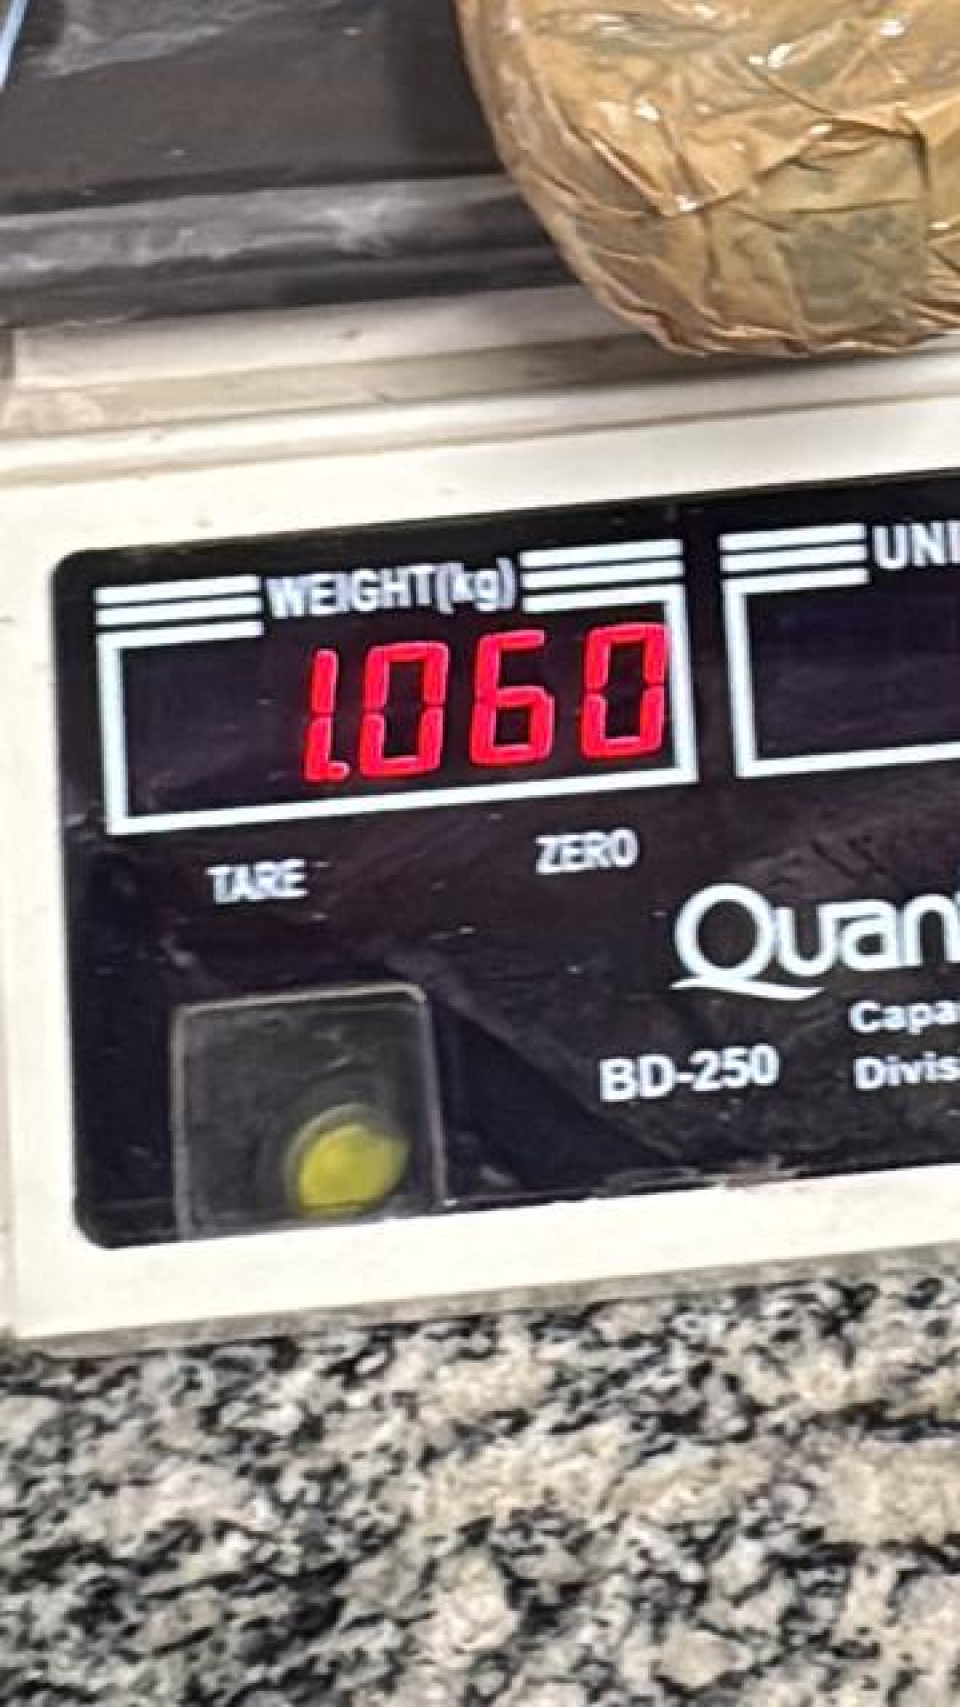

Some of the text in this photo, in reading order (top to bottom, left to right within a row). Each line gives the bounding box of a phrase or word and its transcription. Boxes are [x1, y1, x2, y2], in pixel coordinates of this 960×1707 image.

[265, 557, 517, 620] WEIGHT(kg)
[304, 621, 669, 783] 1.060
[206, 857, 309, 904] TARE
[535, 827, 640, 876] ZERO
[599, 1043, 780, 1103] BD-250
